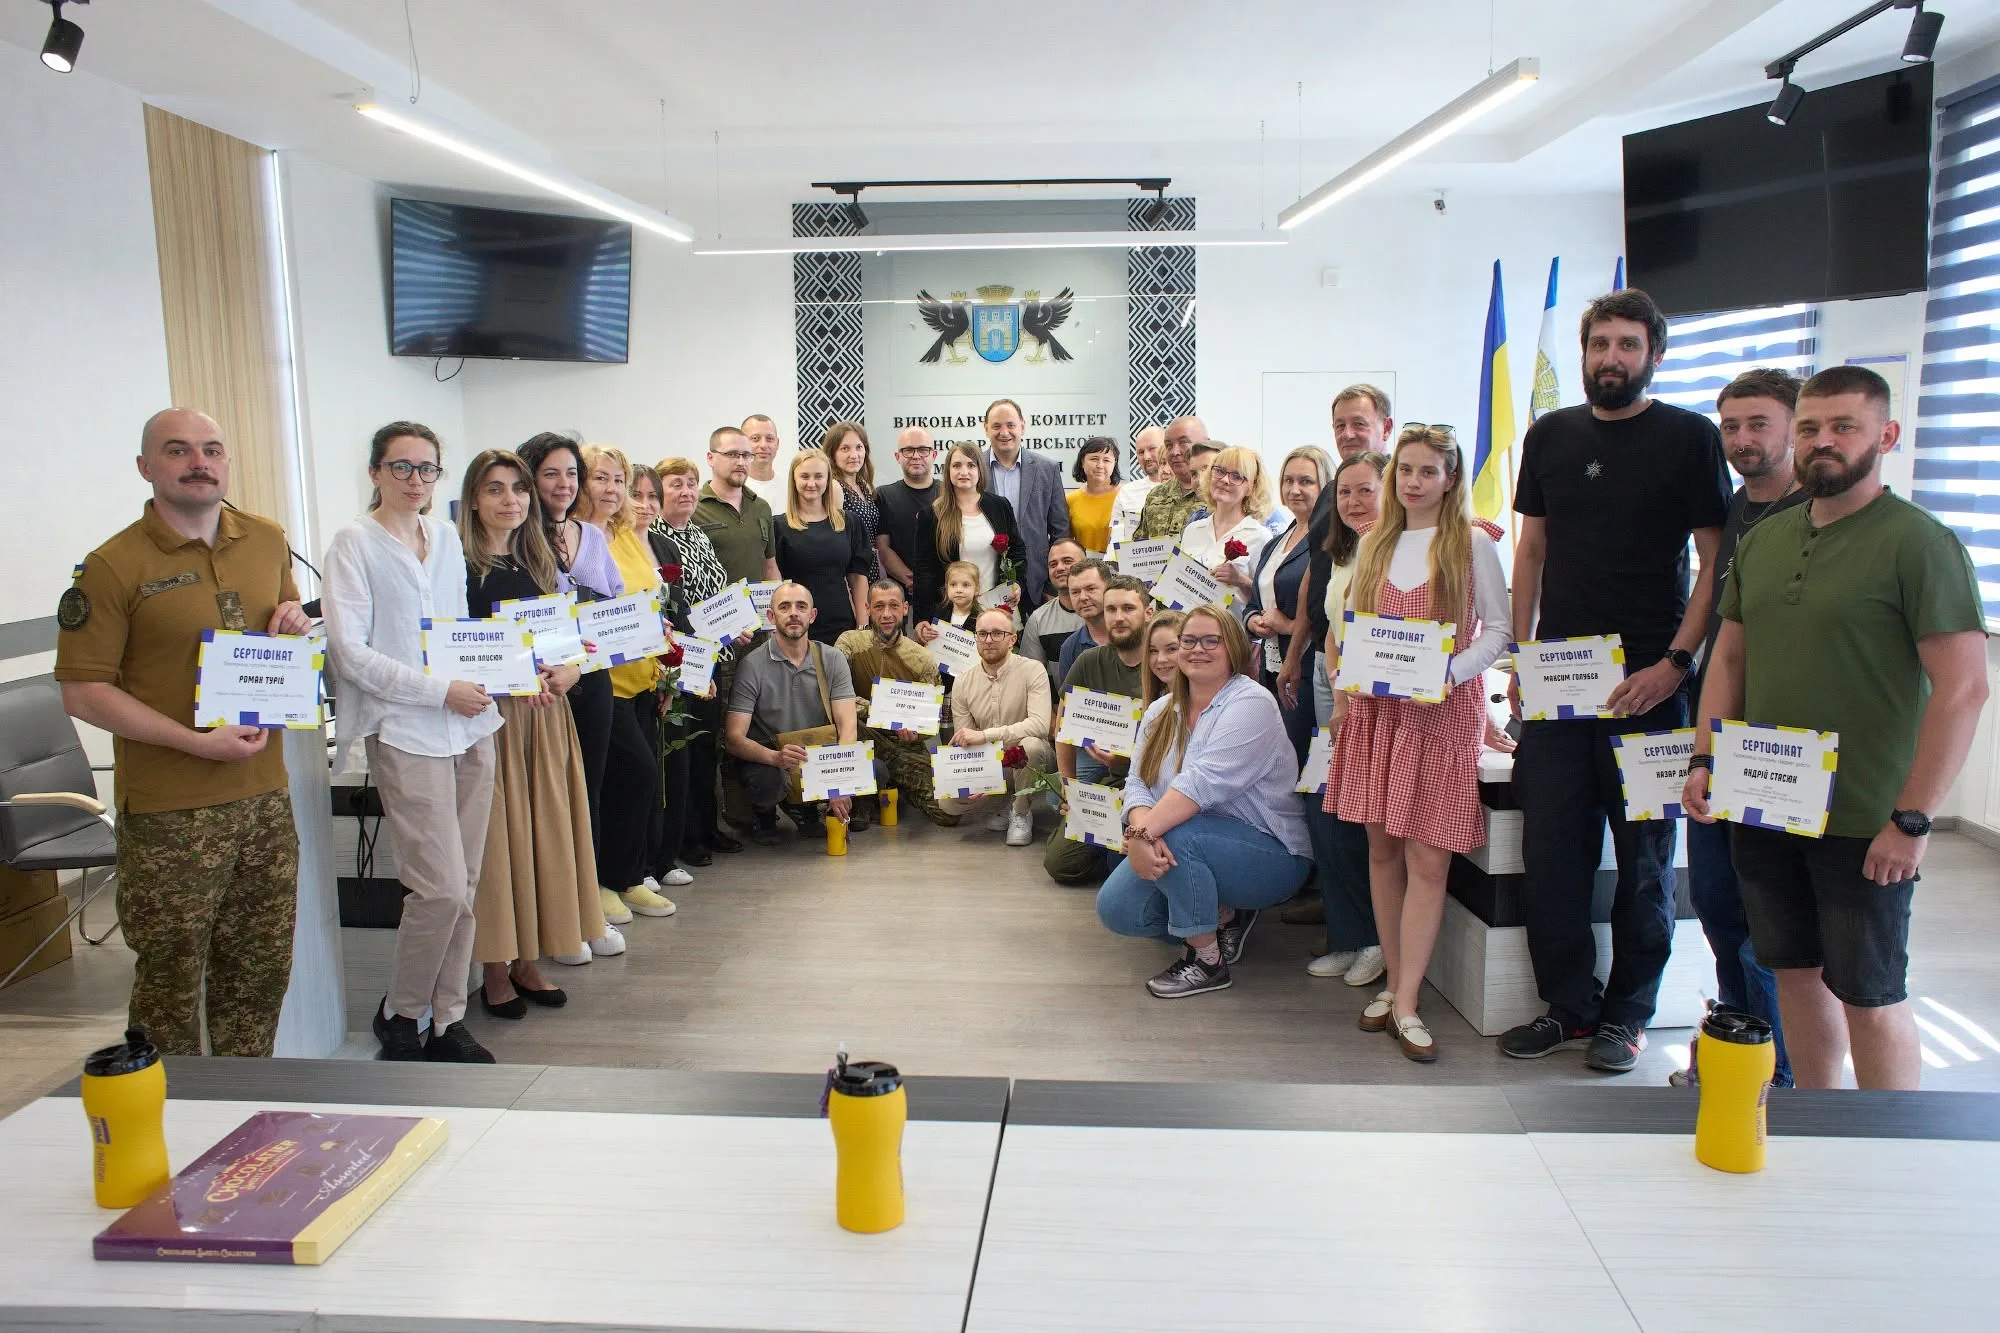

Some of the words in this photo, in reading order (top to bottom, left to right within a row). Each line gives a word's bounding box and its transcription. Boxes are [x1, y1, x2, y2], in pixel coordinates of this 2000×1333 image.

[893, 416, 986, 428] ВИКОНАВЧ
[1030, 413, 1107, 426] КОМІТЕТ
[1131, 544, 1164, 555] СЕРТИФІКАТ
[1184, 565, 1217, 591] СЕРТИФІКАТ
[702, 594, 734, 615] СЕРТИФІКАТ
[515, 606, 556, 619] СЕРТИФІКАТ
[592, 603, 636, 620] СЕРТИФІКАТ
[451, 631, 505, 642] СЕРТИФІКАТ
[597, 628, 614, 638] ОЛЬГА
[945, 631, 976, 648] СЕРТИФІКАТ
[1371, 628, 1425, 643] СЕРТИФІКАТ
[233, 647, 294, 662] СЕРТИФІКАТ
[459, 654, 476, 662] ЮЛІЯ
[1375, 651, 1394, 660] АЛІНА
[1539, 649, 1593, 662] СЕРТИФІКАТ
[239, 675, 263, 684] РОМАН
[265, 675, 285, 685] ТУРІЙ
[1543, 673, 1570, 682] МАКСИМ
[1572, 672, 1599, 681] ГОЛУБЄВ
[890, 687, 925, 698] СЕРТИФІКАТ
[1084, 698, 1122, 712] СЕРТИФІКАТ
[1644, 743, 1695, 757] СЕРТИФІКА
[1742, 739, 1803, 758] СЕРТИФІКАТ
[818, 750, 855, 761] СЕРТИФІКАТ
[949, 751, 985, 761] СЕРТИФІКАТ
[1656, 770, 1676, 778] НАЗАР
[1743, 768, 1769, 780] АНДРІЙ
[1769, 772, 1798, 784] СТАСЮК
[1078, 789, 1107, 802] СЕРТИФІКАТ
